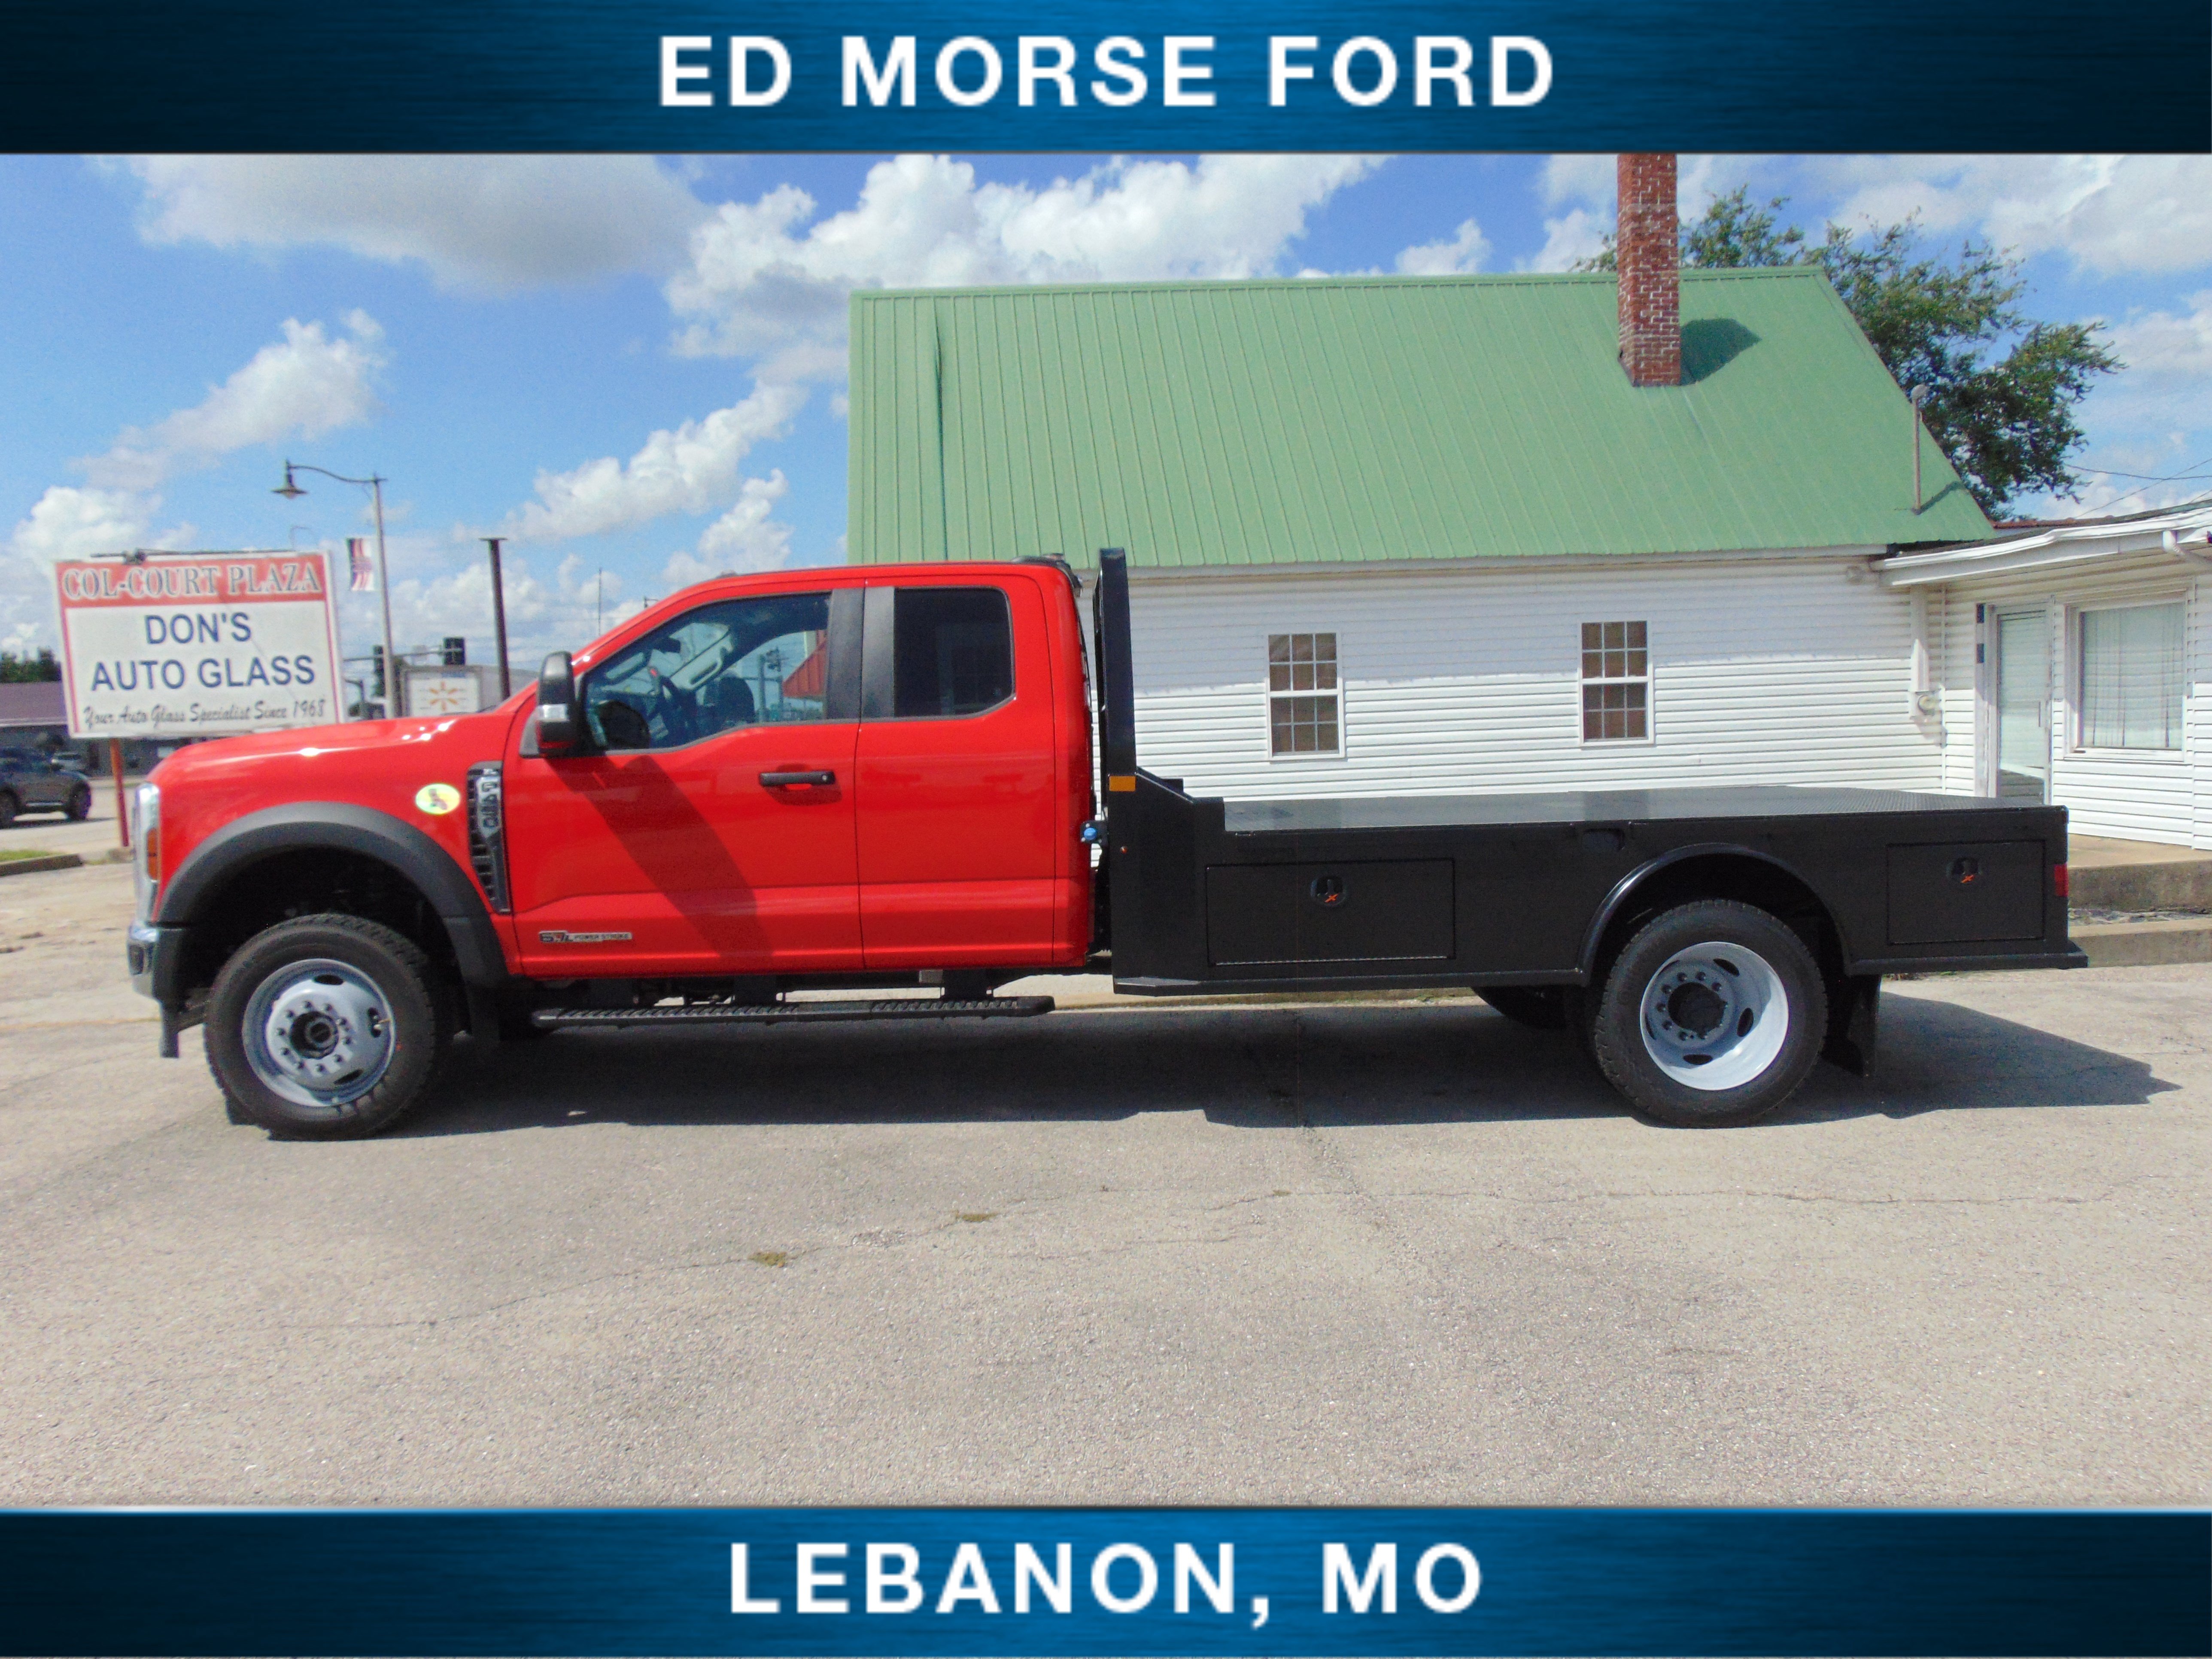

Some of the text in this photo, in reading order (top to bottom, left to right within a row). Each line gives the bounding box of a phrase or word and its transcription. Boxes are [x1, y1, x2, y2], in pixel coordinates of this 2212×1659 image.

[64, 562, 322, 599] COL-COURT PLAZA
[145, 612, 252, 644] DON'S
[91, 655, 315, 691] AUTO GLASS
[83, 705, 114, 730] Your
[117, 705, 148, 724] Auto
[151, 704, 186, 729] Glass
[189, 702, 251, 726] Specialist
[253, 700, 287, 720] Since
